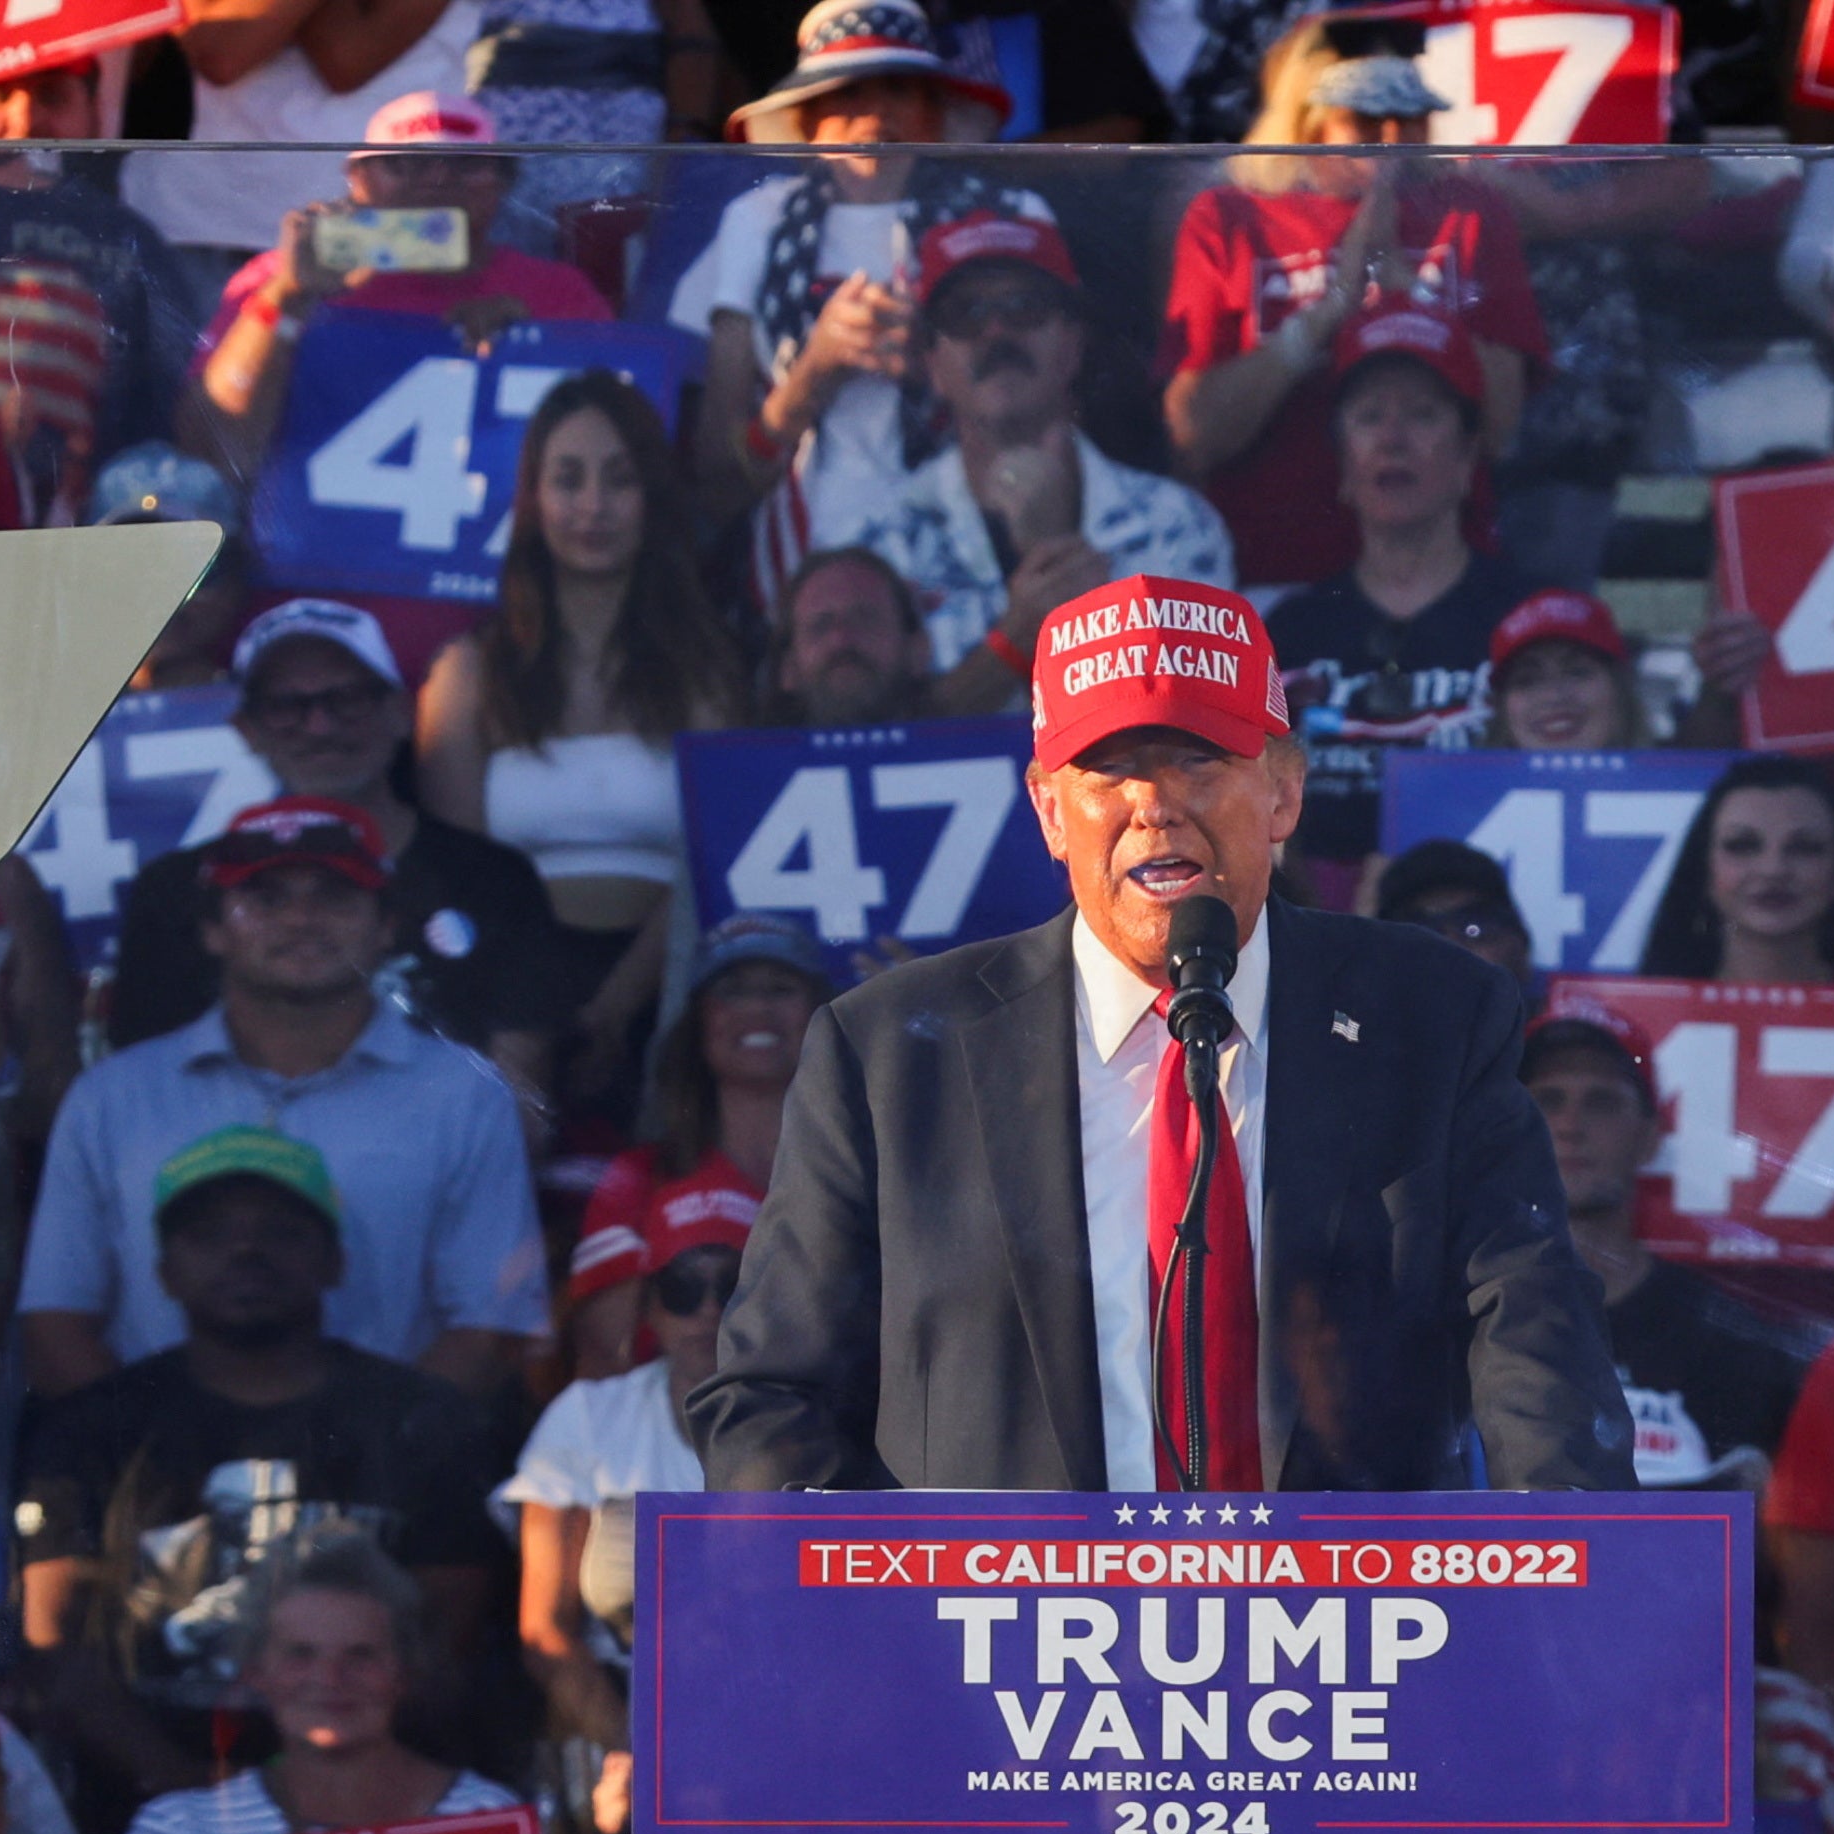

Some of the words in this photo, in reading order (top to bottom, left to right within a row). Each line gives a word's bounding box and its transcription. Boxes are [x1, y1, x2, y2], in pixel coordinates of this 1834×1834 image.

[1049, 604, 1122, 657] MAKE
[1124, 597, 1252, 646] AMERICA
[1063, 643, 1149, 696] GREAT
[1153, 642, 1240, 688] AGAIN
[726, 756, 1018, 943] 47
[1462, 788, 1712, 971] 47
[811, 1545, 946, 1583] TEXT
[964, 1544, 1305, 1584] CALIFORNIA
[1320, 1544, 1393, 1584] TO
[1410, 1544, 1577, 1584] 88022
[938, 1597, 1450, 1686] TRUMP
[994, 1690, 1389, 1761] VANCE
[968, 1771, 1051, 1791] MAKE
[1060, 1771, 1196, 1791] AMERICA
[1206, 1771, 1302, 1791] GREAT
[1313, 1771, 1418, 1791] AGAIN!
